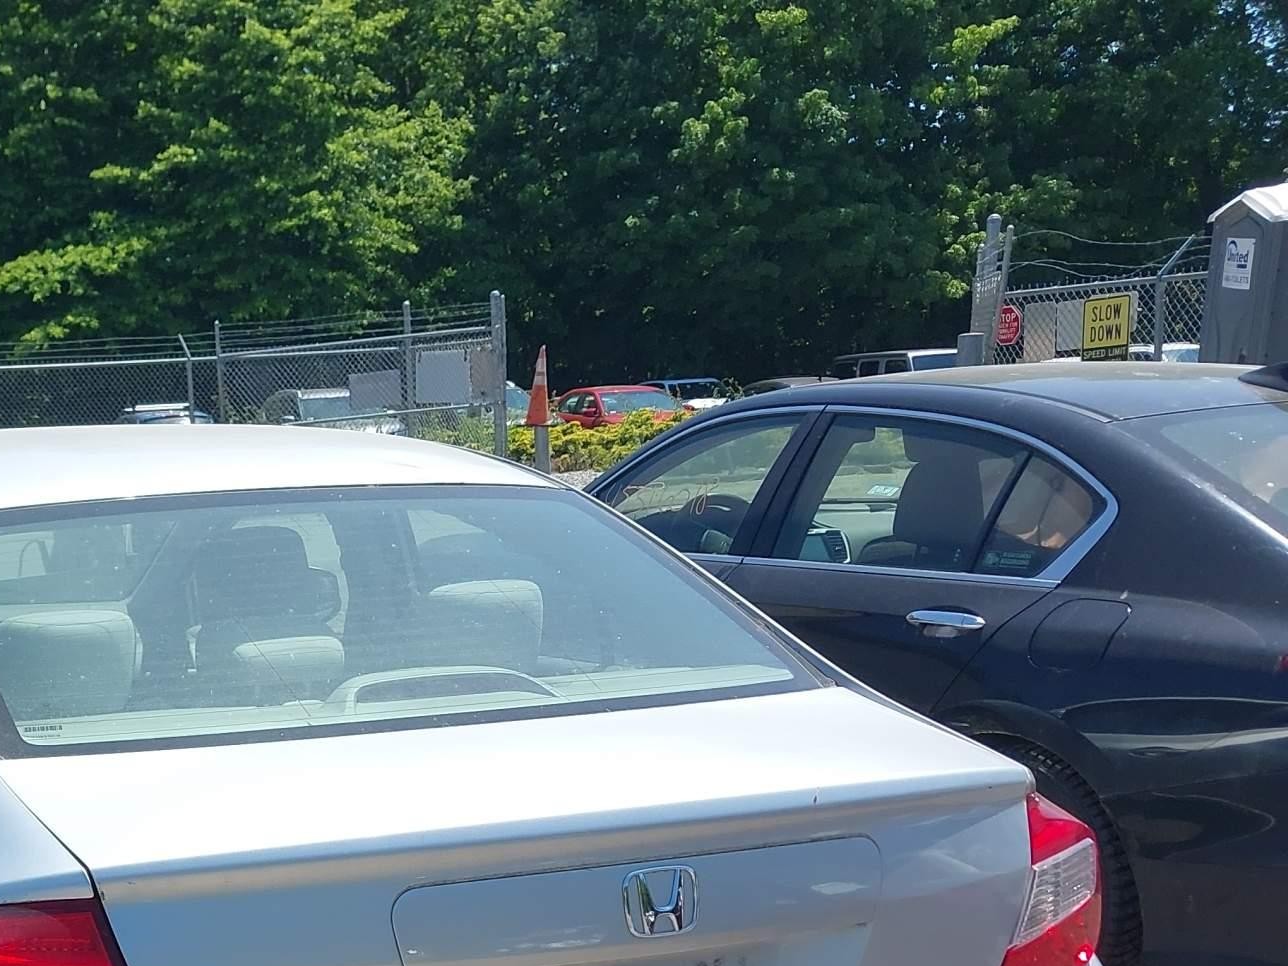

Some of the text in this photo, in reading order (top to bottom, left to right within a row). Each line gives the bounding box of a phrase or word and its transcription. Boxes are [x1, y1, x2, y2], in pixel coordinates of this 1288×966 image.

[1000, 312, 1017, 323] TOP
[1091, 303, 1123, 322] SLOW
[1090, 323, 1122, 343] DOWN
[1083, 347, 1127, 360] SPEED LIMIT
